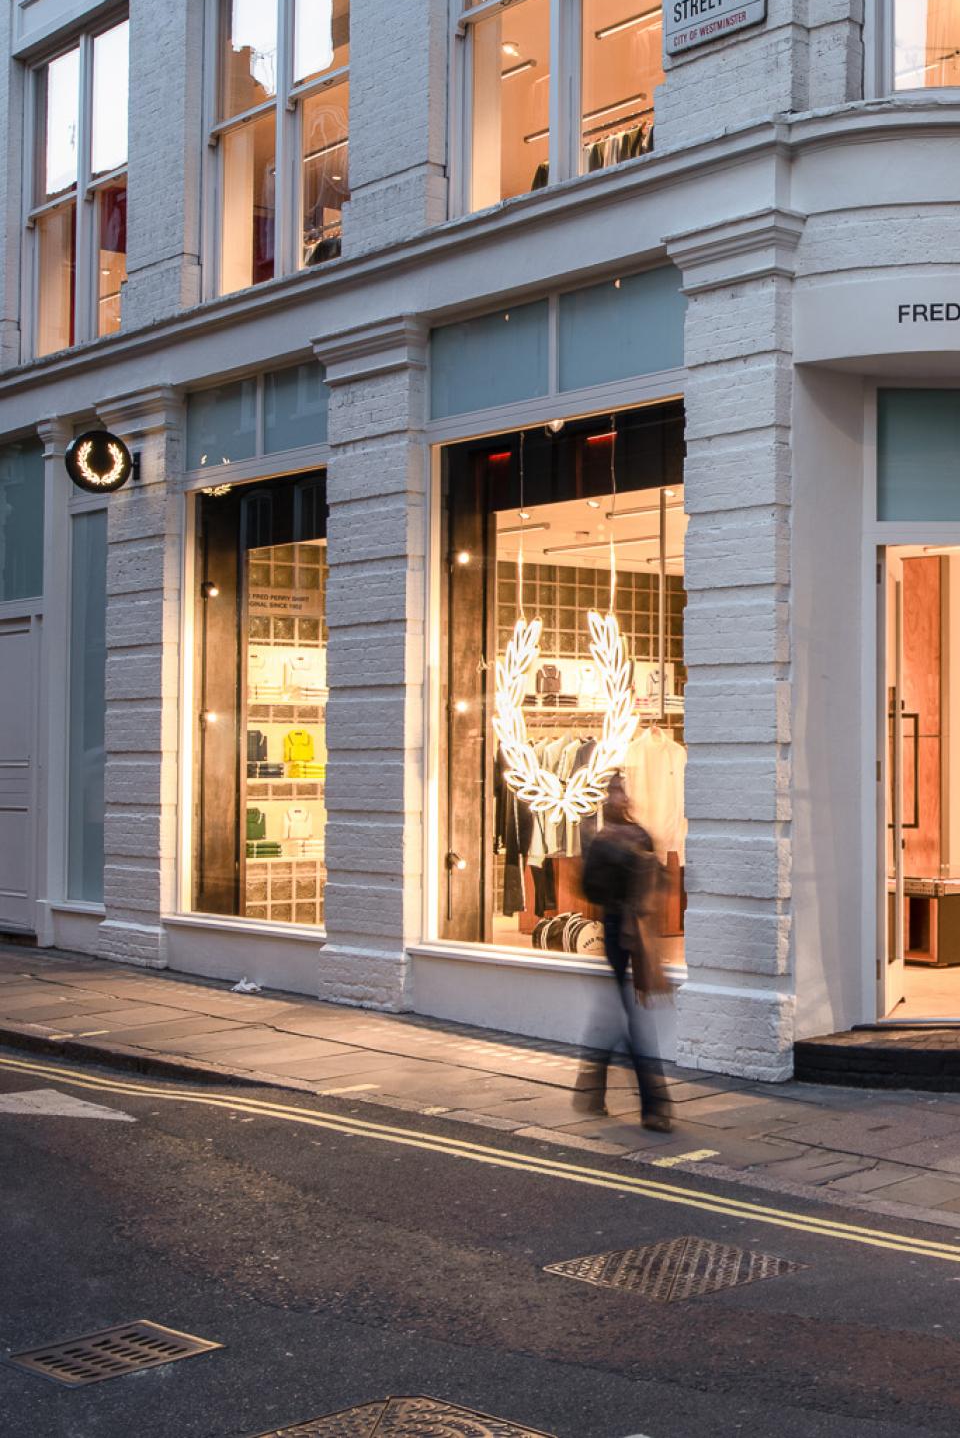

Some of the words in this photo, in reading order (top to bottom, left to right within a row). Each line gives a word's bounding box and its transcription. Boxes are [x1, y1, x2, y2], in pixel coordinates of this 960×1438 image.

[673, 33, 688, 47] CITY
[689, 28, 698, 41] OF
[699, 11, 747, 36] WESTMINSTER
[252, 593, 269, 601] FRED
